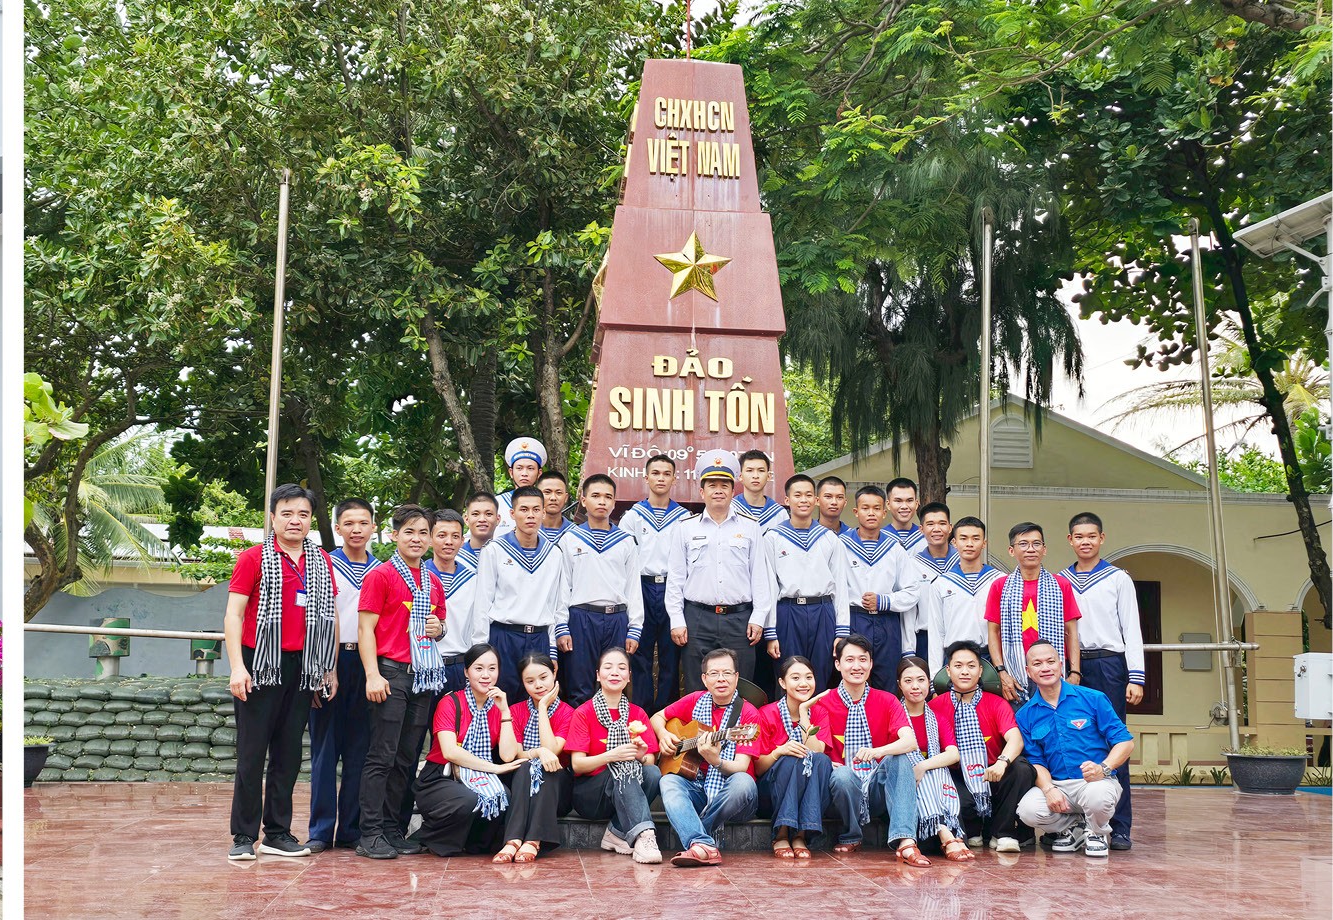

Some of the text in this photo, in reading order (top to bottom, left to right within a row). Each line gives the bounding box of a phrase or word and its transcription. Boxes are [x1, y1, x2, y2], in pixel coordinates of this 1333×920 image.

[654, 96, 735, 132] CHXHCN
[647, 132, 740, 181] VIỆT NAM
[651, 349, 734, 379] ĐẢO
[609, 376, 775, 434] SINH TỒN
[608, 444, 630, 458] VĨ
[607, 466, 646, 478] KINH
